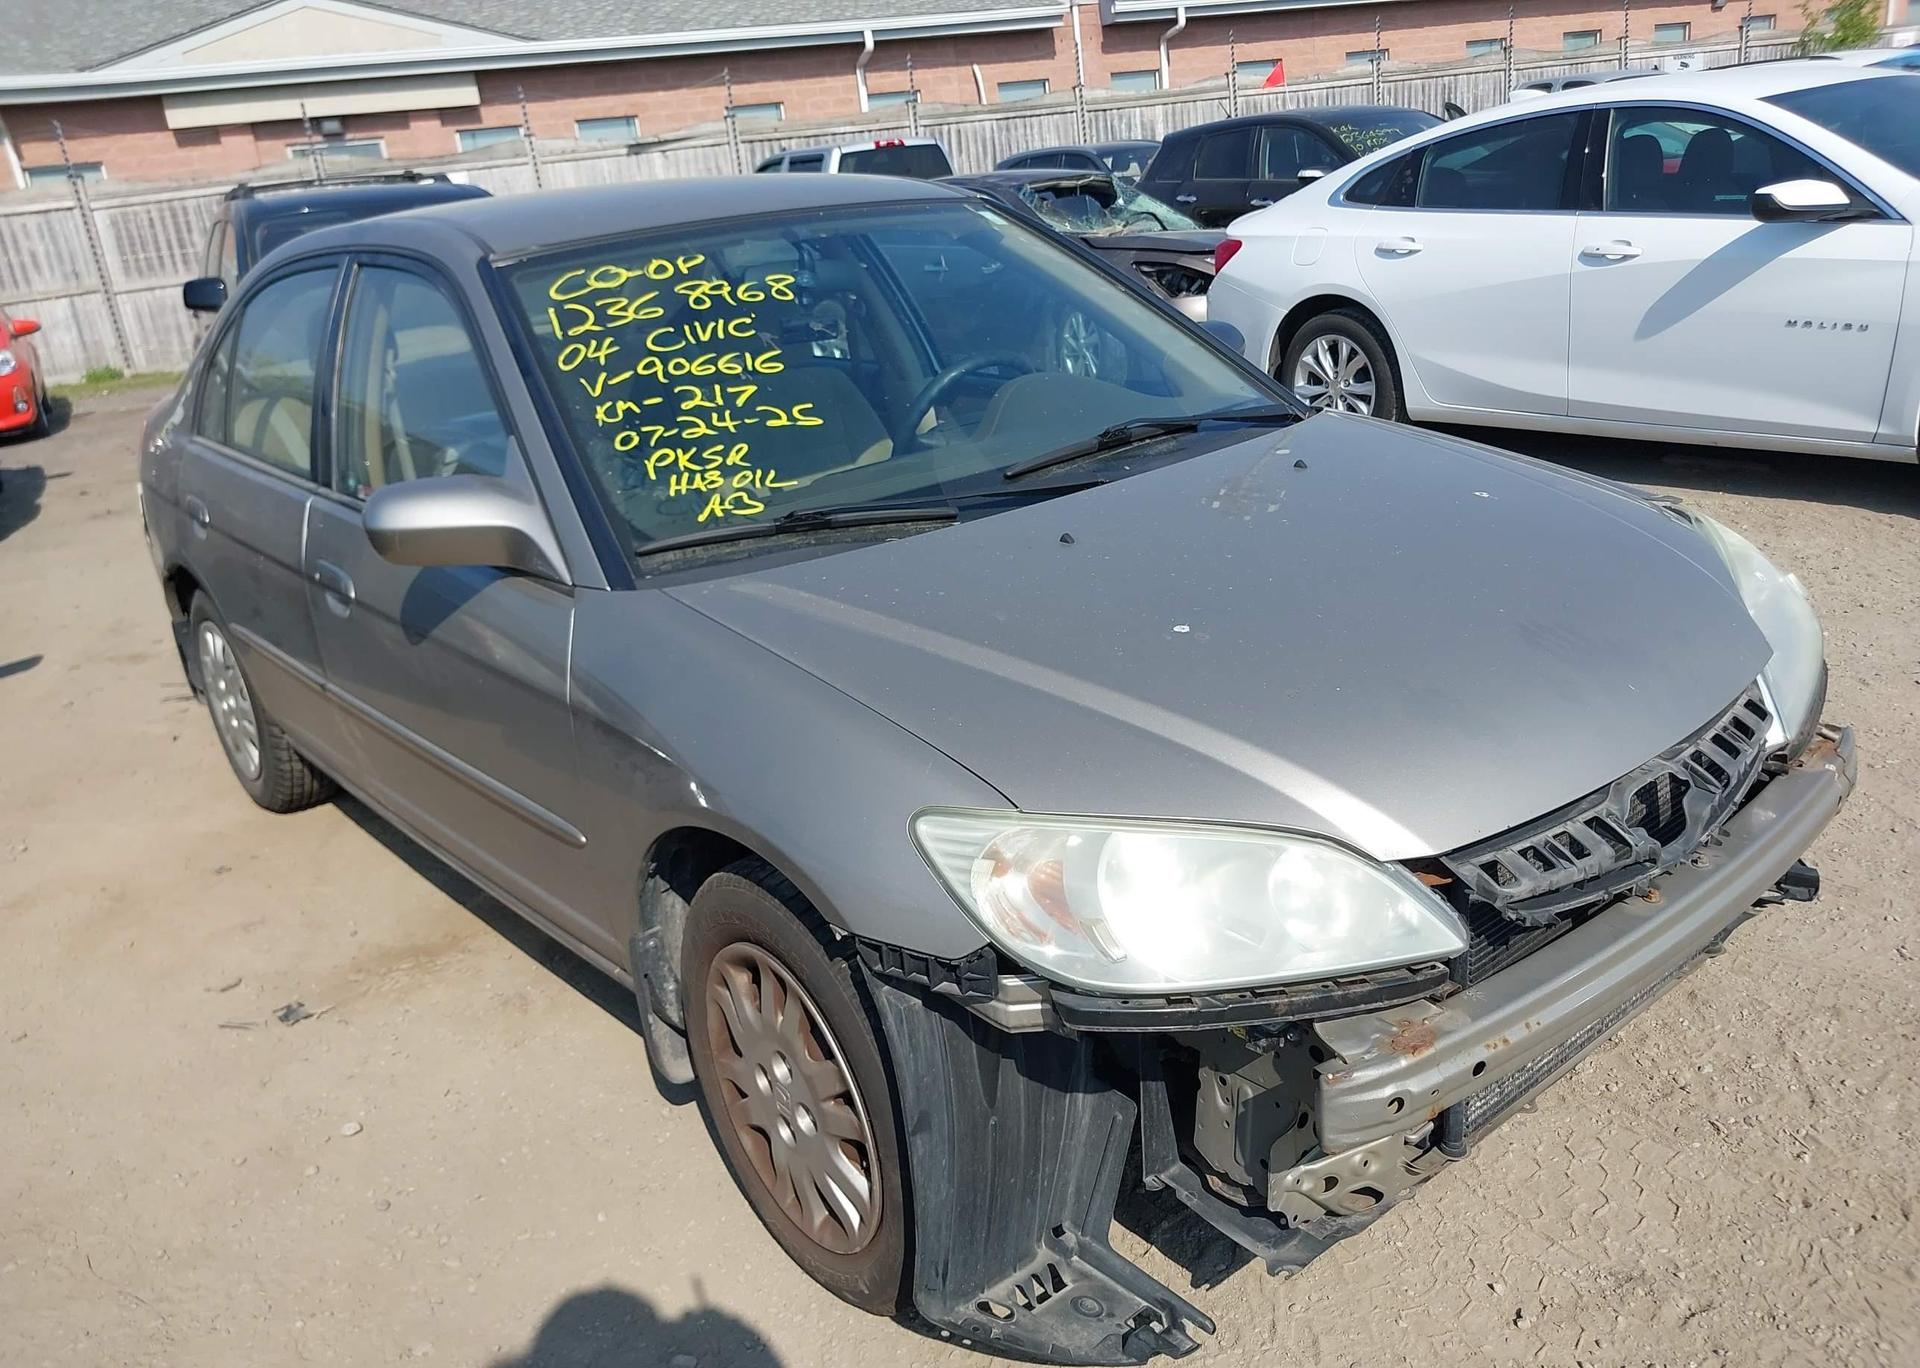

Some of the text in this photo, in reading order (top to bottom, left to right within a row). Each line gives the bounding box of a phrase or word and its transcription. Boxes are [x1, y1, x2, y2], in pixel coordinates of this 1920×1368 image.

[549, 254, 705, 300] CO-OP
[548, 274, 795, 340] 1236 8968
[1784, 319, 1868, 332] MALIBU
[557, 316, 757, 371] 04 CIVIC
[579, 350, 785, 397] V-906616
[613, 403, 824, 451] 07-24-25
[644, 442, 752, 480] PKSR
[731, 468, 799, 489] OIL
